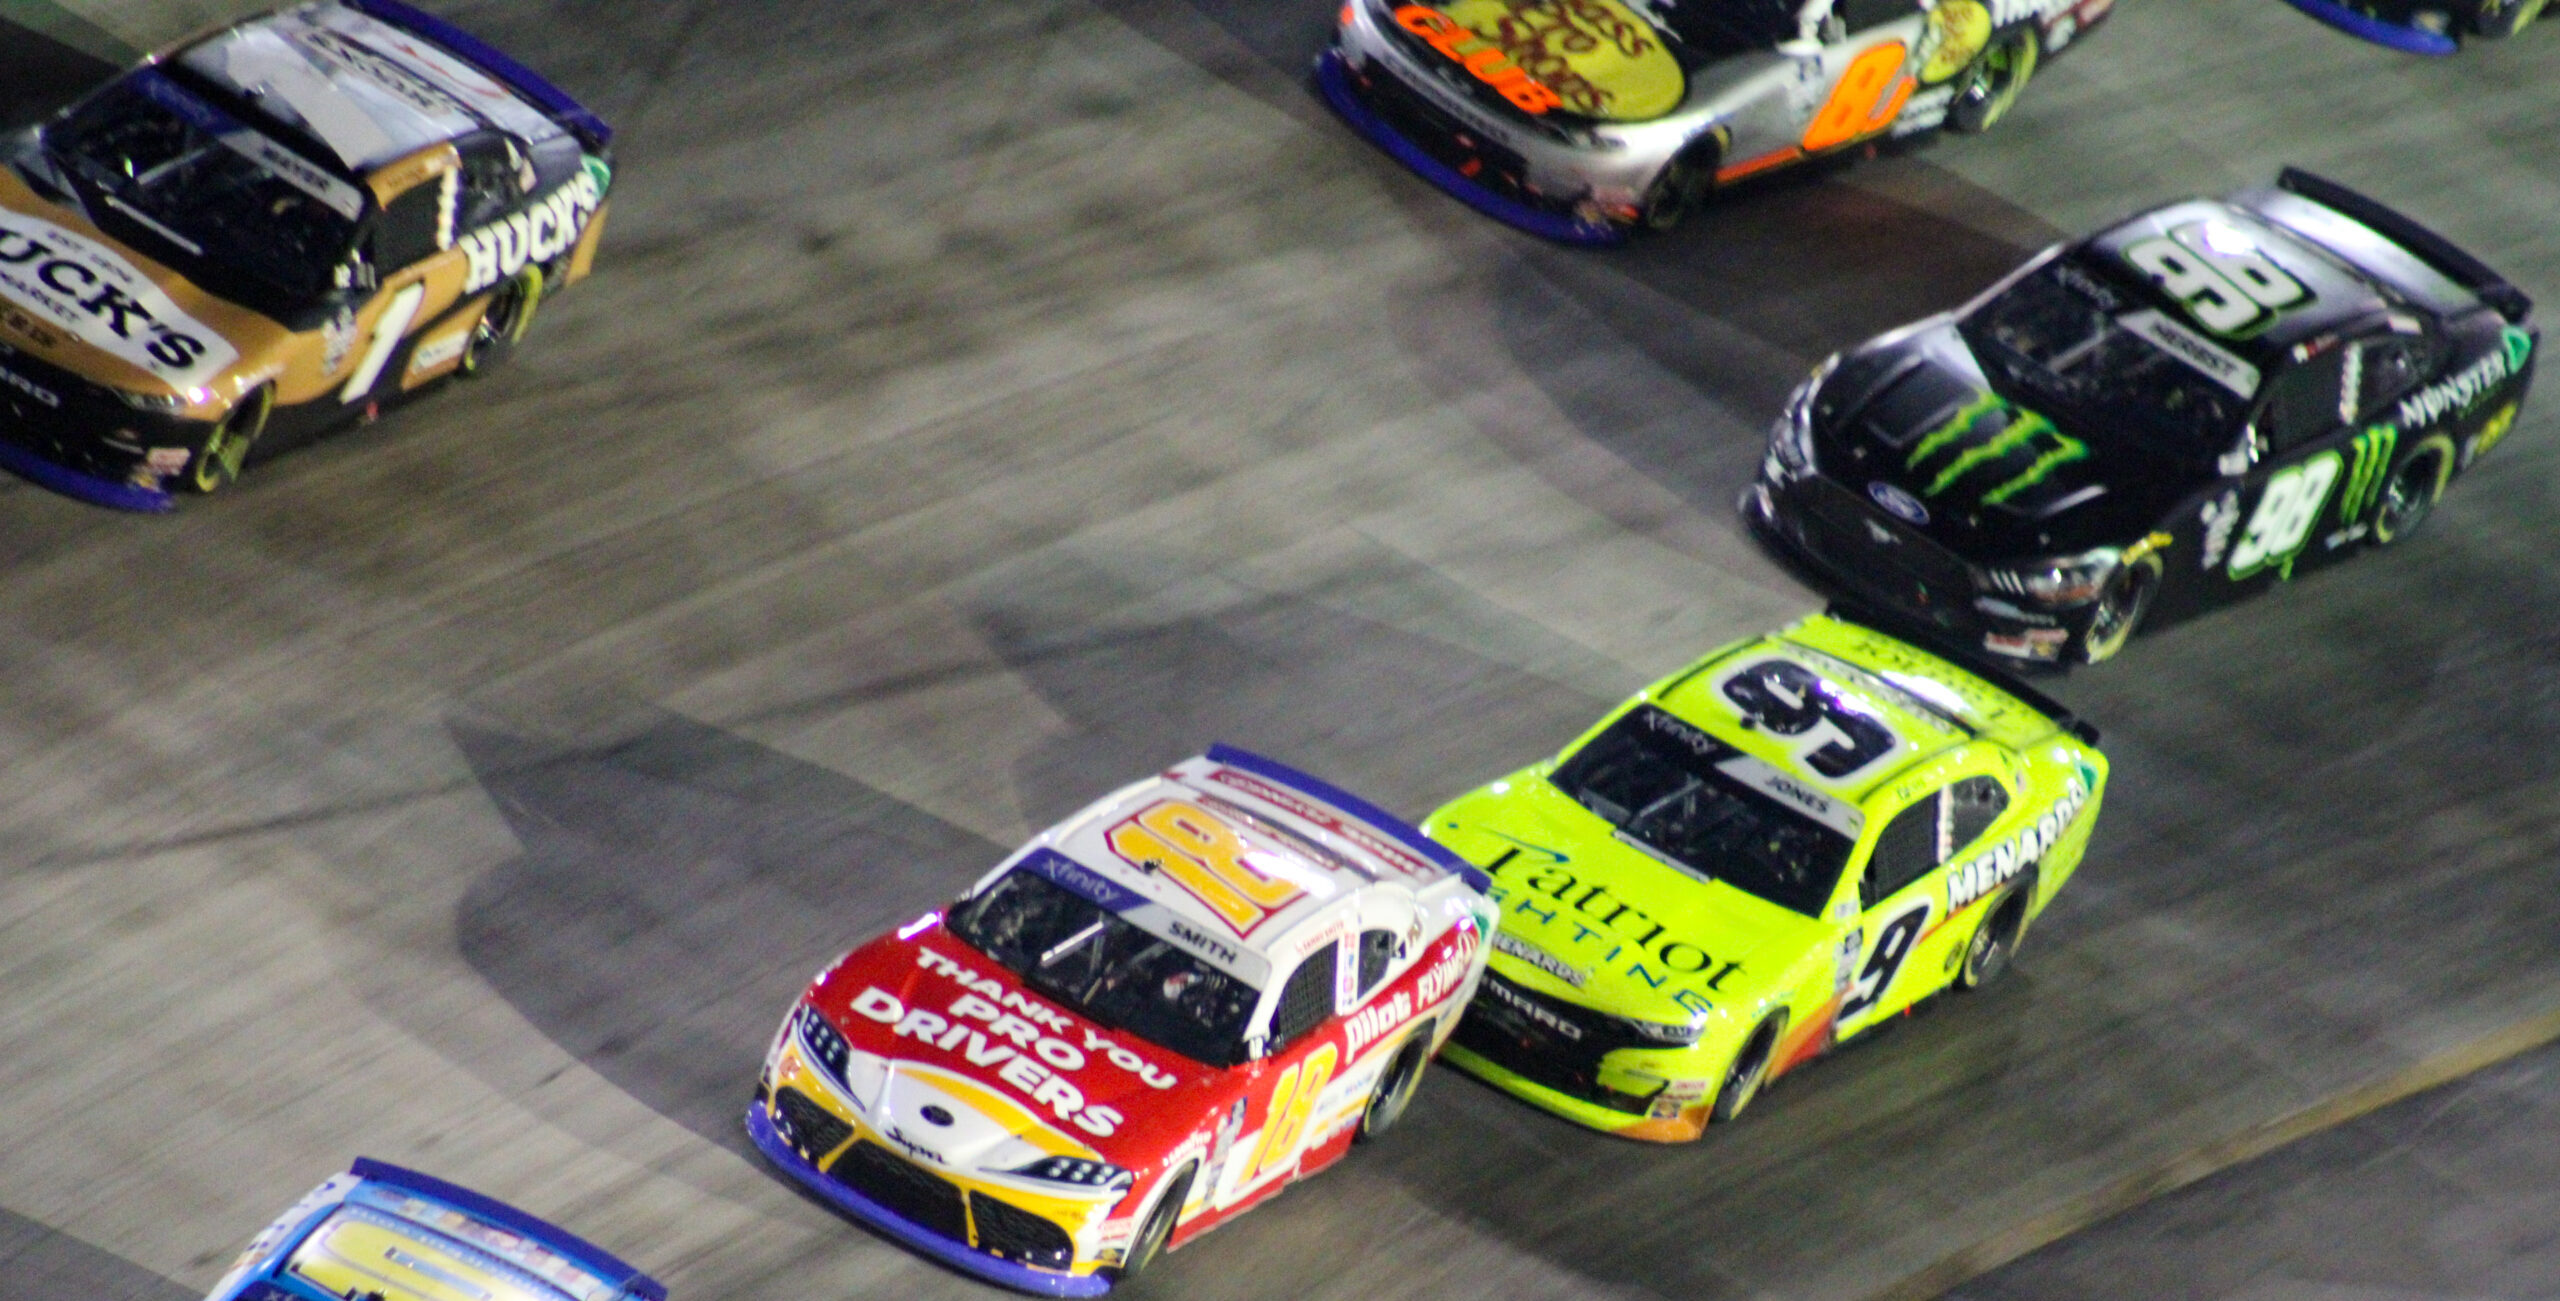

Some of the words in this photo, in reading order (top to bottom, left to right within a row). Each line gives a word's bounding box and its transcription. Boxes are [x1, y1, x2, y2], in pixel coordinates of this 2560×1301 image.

[1394, 4, 1563, 115] CLUB
[1802, 41, 1918, 152] 8
[2121, 221, 2306, 336] 98
[340, 280, 424, 404] 1
[2229, 452, 2342, 577] 98
[1722, 657, 1898, 779] 9
[1764, 775, 1829, 816] JONES
[1041, 855, 1123, 903] xfinity
[1103, 798, 1312, 940] 18
[1167, 920, 1239, 966] SMITH
[1490, 886, 1714, 1021] HTING
[1836, 903, 1931, 1022] 9
[849, 985, 1125, 1138] DRIVERS
[914, 945, 1074, 1034] THANK
[1082, 1027, 1178, 1090] YOU
[947, 992, 1086, 1071] PRO
[1343, 990, 1412, 1067] pilot
[1237, 1040, 1339, 1186] 18
